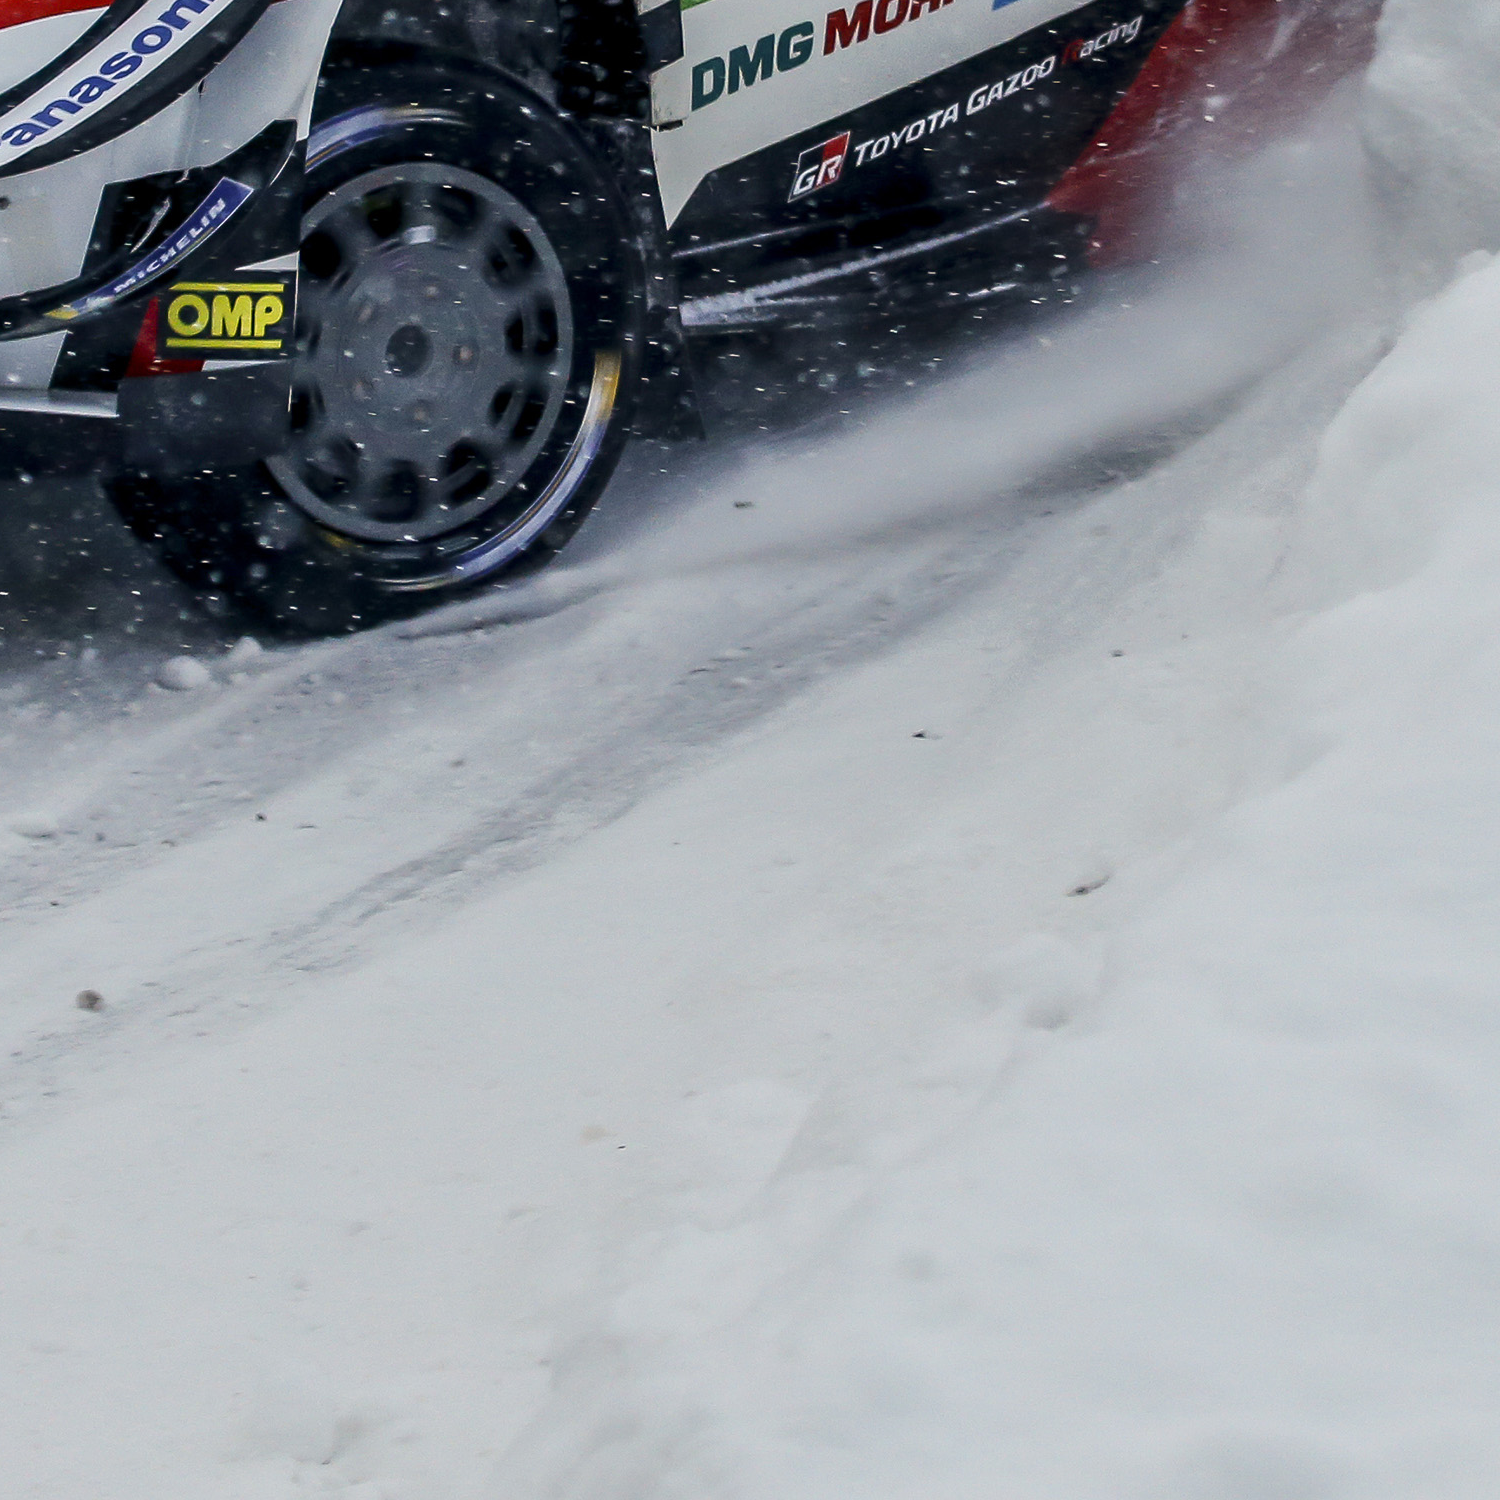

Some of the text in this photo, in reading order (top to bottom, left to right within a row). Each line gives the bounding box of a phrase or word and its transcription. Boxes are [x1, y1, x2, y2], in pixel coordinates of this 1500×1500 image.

[690, 20, 815, 112] DMG
[792, 15, 1143, 196] GR TOYOTA GAZOO Racing
[113, 198, 226, 293] MICHELIN
[168, 293, 284, 338] OMP
